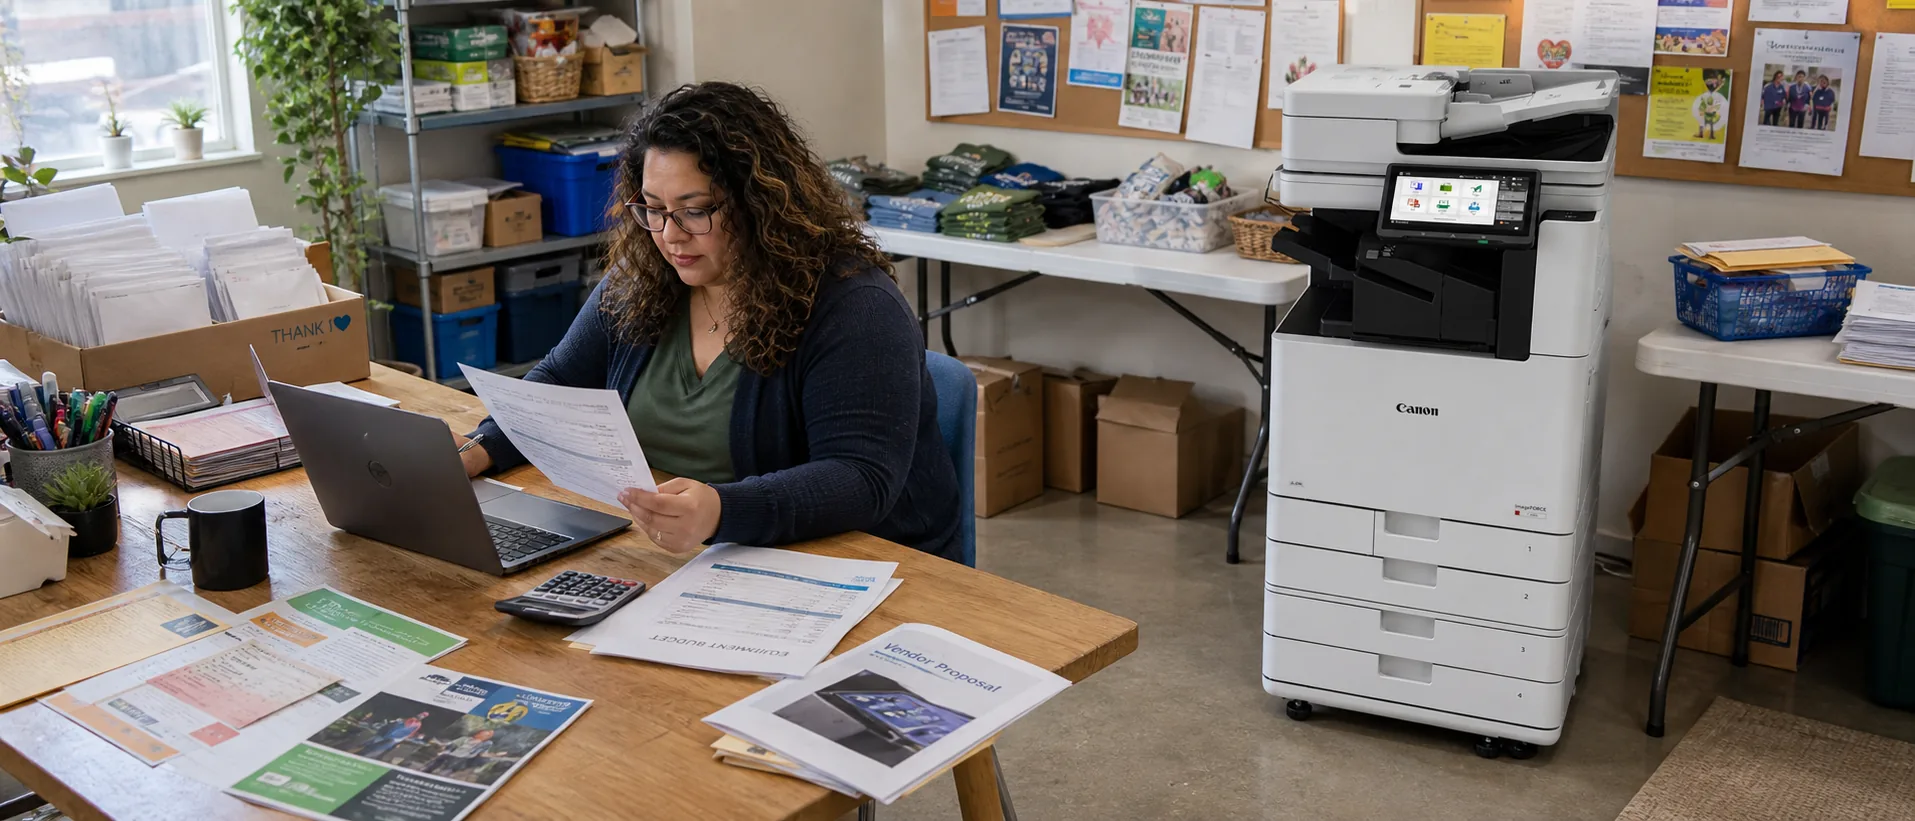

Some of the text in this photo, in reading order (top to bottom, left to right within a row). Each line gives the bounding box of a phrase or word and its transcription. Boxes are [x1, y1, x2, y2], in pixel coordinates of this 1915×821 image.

[271, 320, 324, 344] THANK
[1396, 403, 1439, 417] Canon
[649, 634, 706, 647] BUDGET
[883, 642, 935, 665] Vendor
[934, 662, 1003, 693] Proposal
